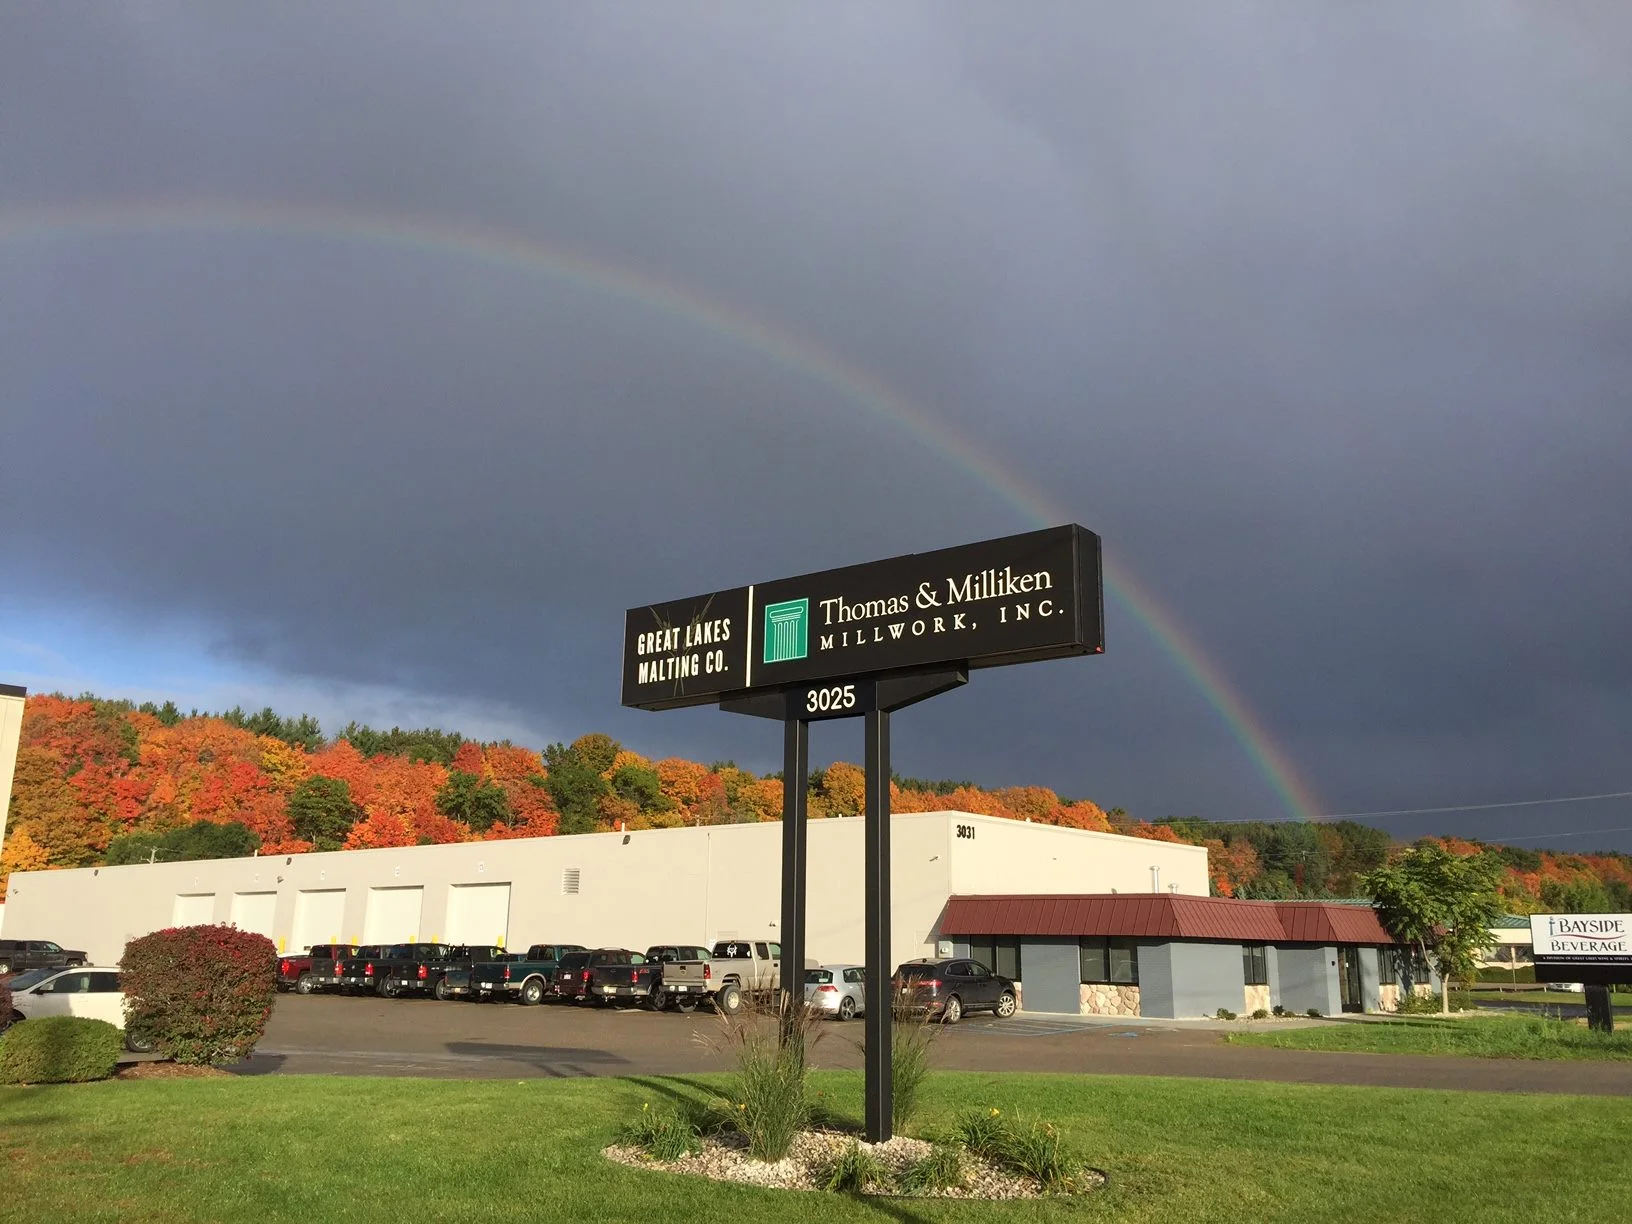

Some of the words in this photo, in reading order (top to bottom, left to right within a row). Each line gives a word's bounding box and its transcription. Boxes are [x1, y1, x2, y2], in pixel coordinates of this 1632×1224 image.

[820, 596, 909, 626] Thomas
[915, 582, 942, 609] &
[946, 566, 1053, 605] Milliken
[637, 627, 681, 655] GREAT
[685, 618, 731, 647] LAKES
[820, 613, 977, 650] MILLWORK,
[1000, 600, 1064, 623] INC.
[638, 653, 699, 684] MALTING
[705, 649, 729, 674] CO.
[806, 685, 856, 712] 3025
[956, 824, 975, 839] 3031
[1559, 918, 1625, 933] BAYSIDE
[1551, 939, 1628, 952] BEVERAGE
